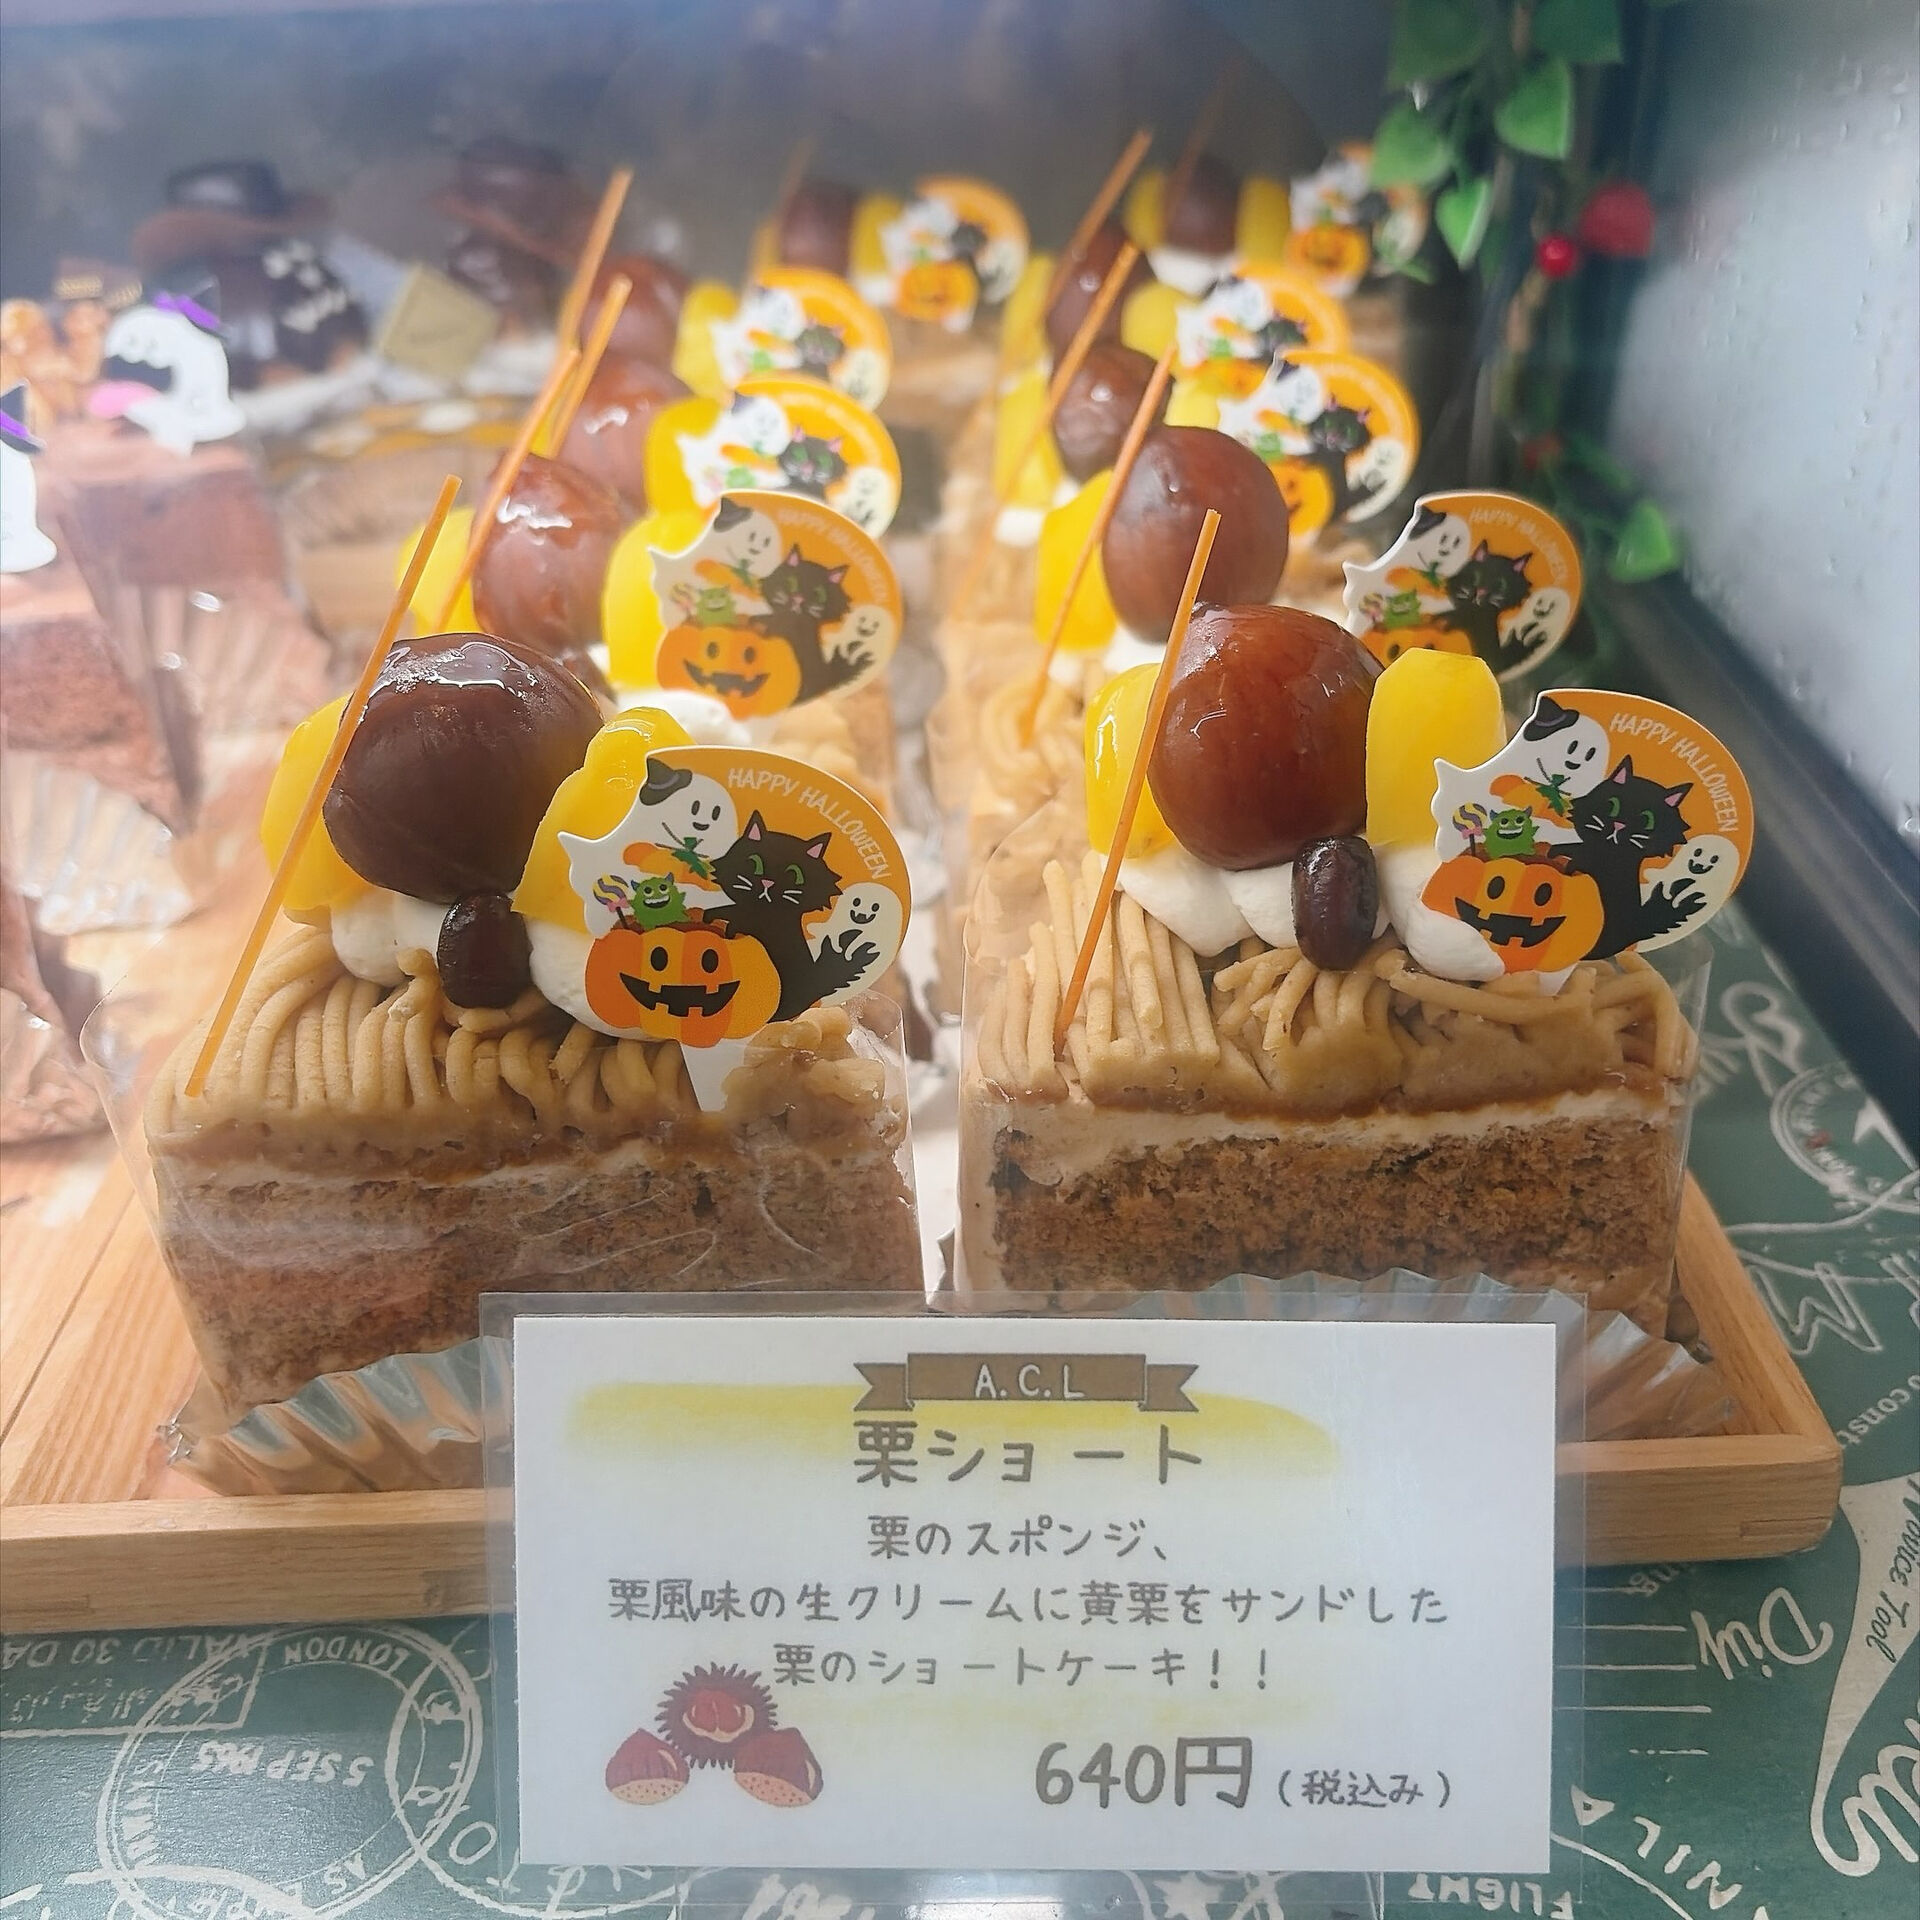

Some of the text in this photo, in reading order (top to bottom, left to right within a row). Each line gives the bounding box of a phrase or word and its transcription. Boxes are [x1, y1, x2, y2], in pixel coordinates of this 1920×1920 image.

[1609, 712, 1739, 833] HAPPY HALLOWEEN
[728, 767, 892, 880] HAPPY HALLOWEEN
[975, 1364, 1085, 1398] A.C.L
[1836, 1387, 1910, 1449] const
[853, 1420, 1203, 1488] 栗ショート
[867, 1514, 1167, 1560] 栗のスポンジ、
[608, 1577, 1448, 1627] 栗風味の生クリームに黄栗をサンドした
[1866, 1590, 1910, 1664] Tool
[70, 1638, 121, 1665] 30
[284, 1635, 411, 1675] LONDON
[1690, 1587, 1834, 1681] Diy
[267, 1749, 343, 1784] SEP
[1035, 1736, 1253, 1809] 640円
[1408, 1873, 1574, 1920] FLIGHT
